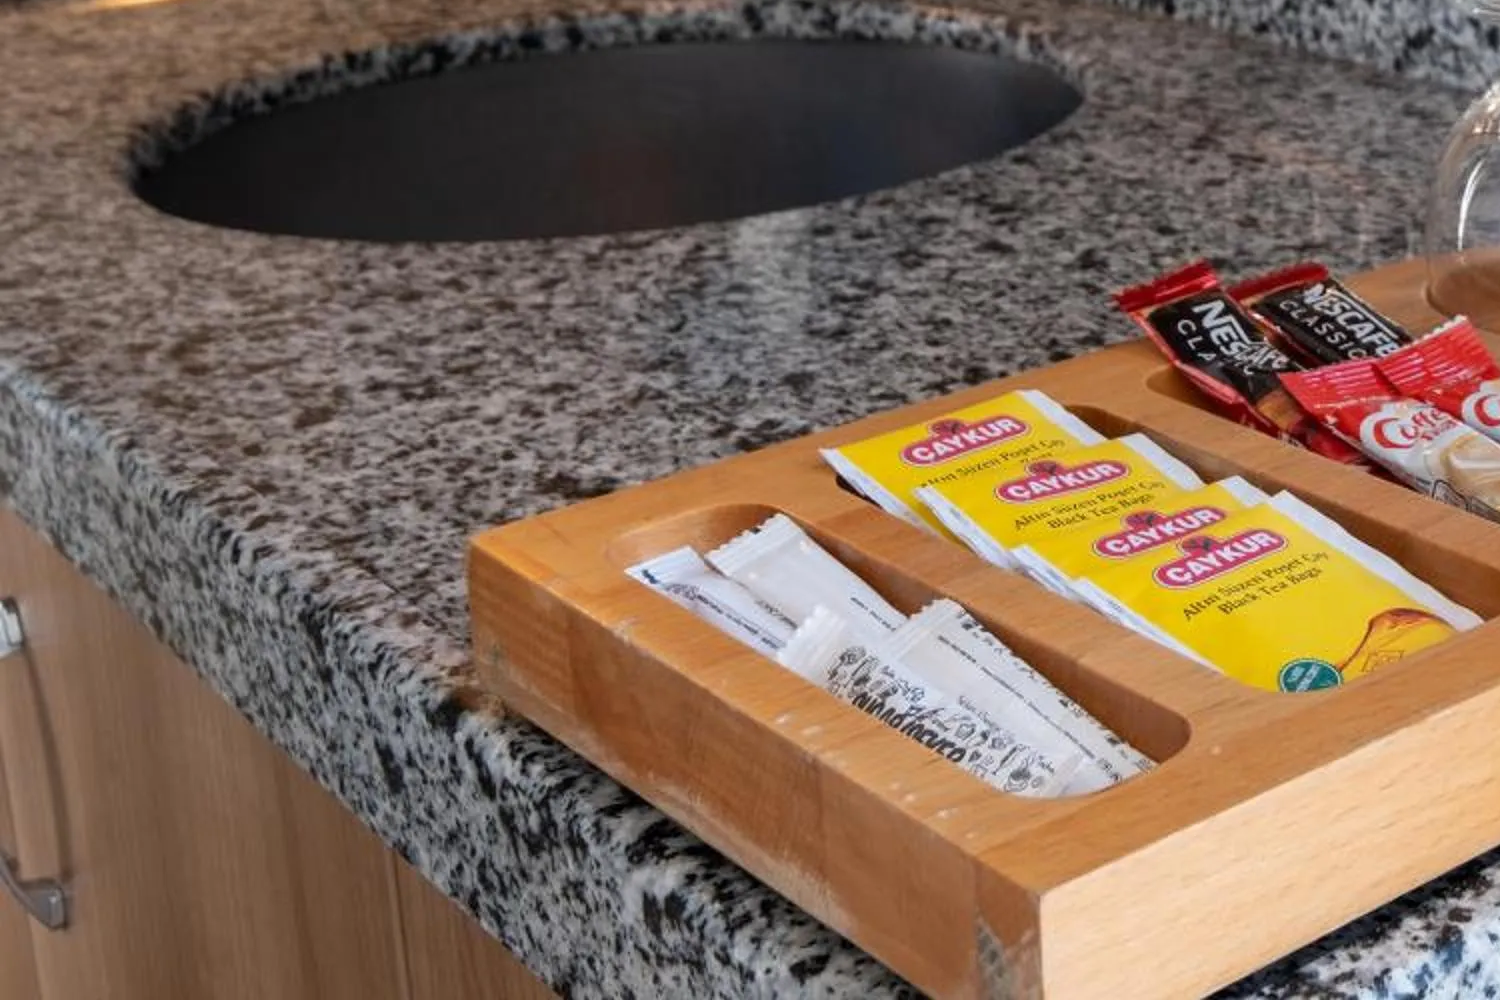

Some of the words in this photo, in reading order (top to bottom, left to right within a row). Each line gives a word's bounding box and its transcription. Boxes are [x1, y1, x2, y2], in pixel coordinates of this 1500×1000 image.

[1279, 299, 1368, 360] CLASSIC
[1047, 511, 1089, 530] Black
[1087, 501, 1120, 519] Tea
[1118, 492, 1156, 509] Bags
[1166, 530, 1279, 586] ÇAYKUR
[1217, 591, 1259, 616] Black
[1257, 580, 1289, 598] Tea
[1284, 566, 1324, 586] Bags
